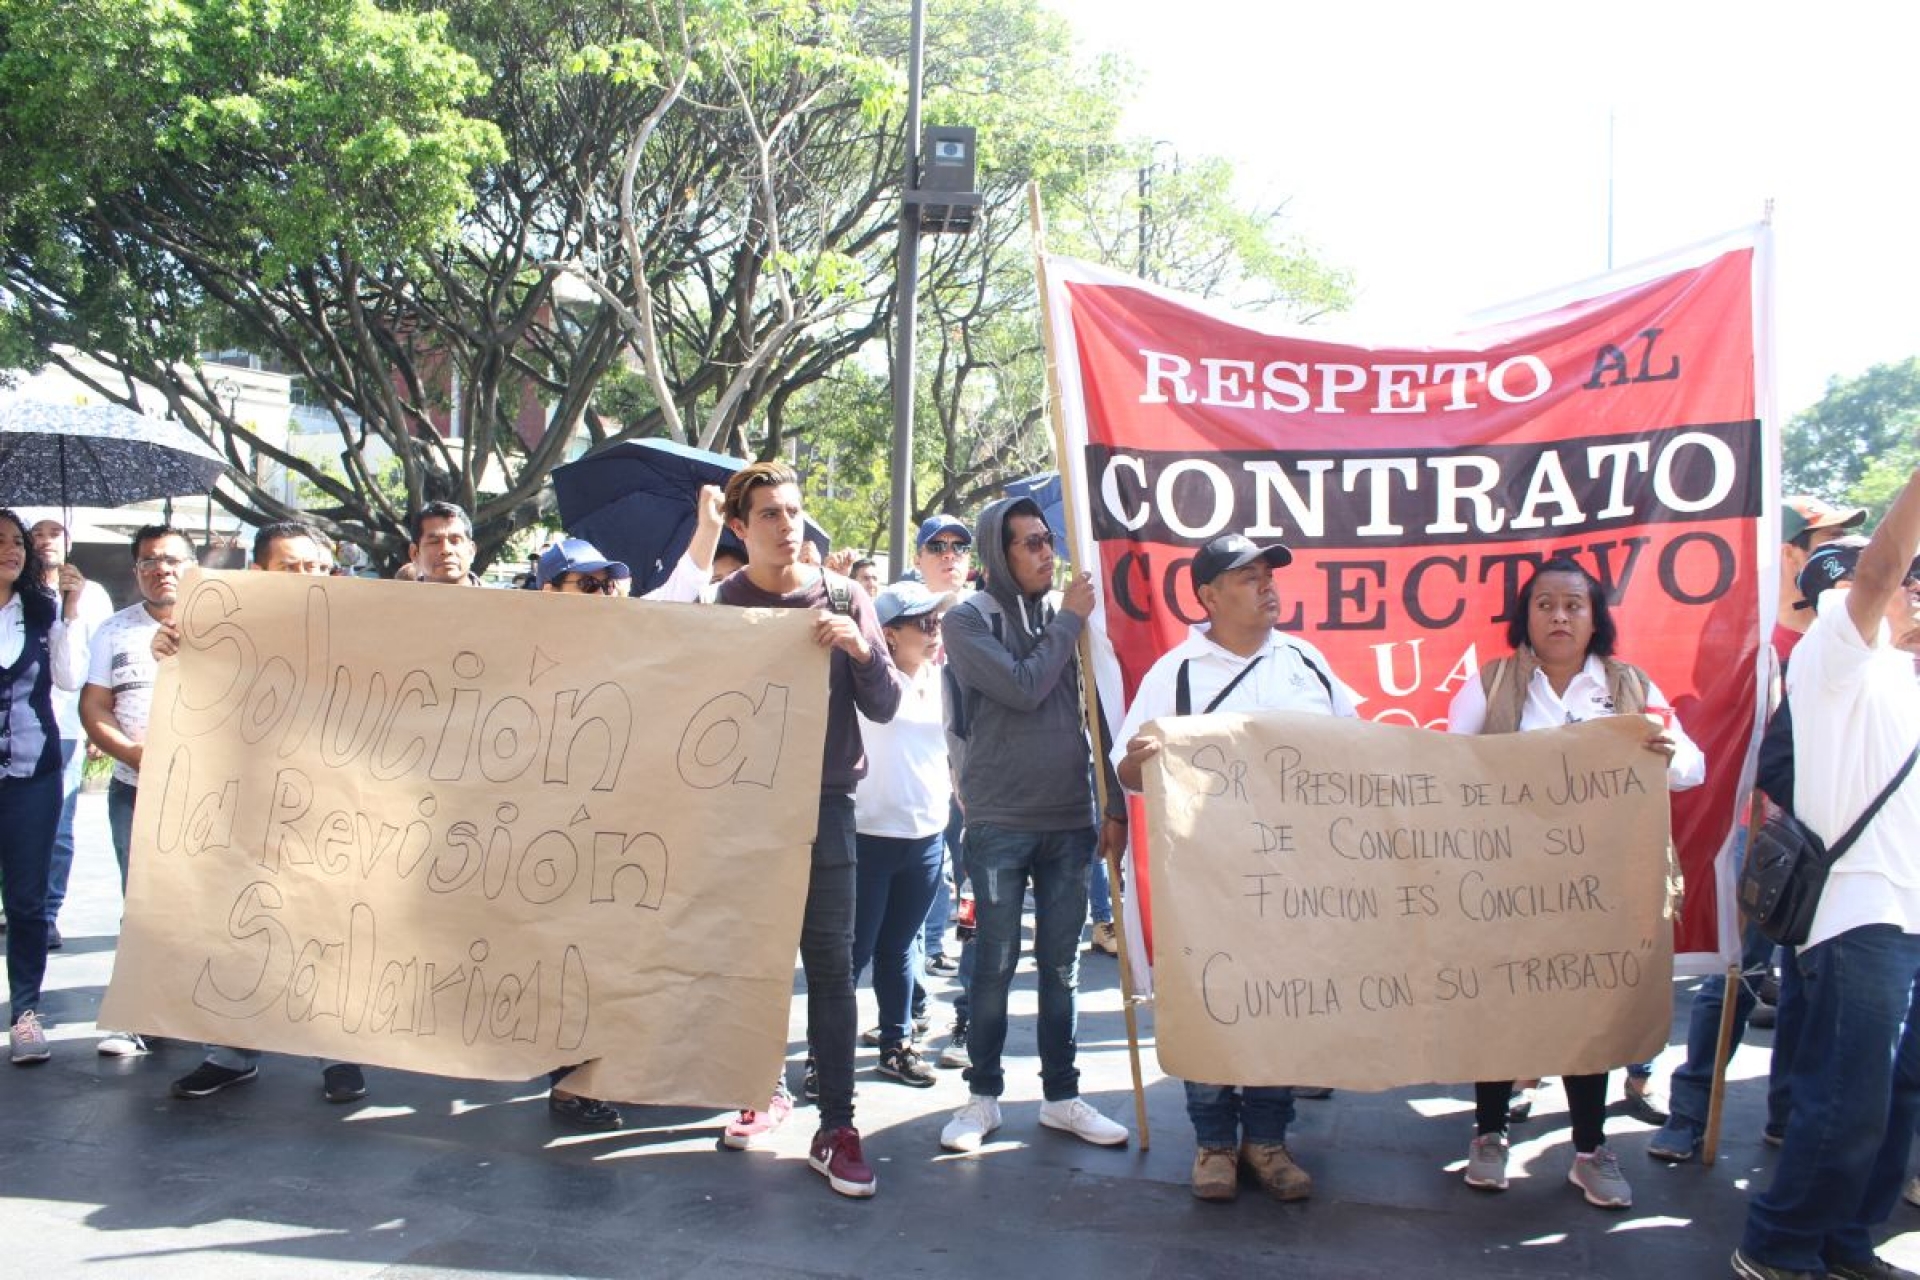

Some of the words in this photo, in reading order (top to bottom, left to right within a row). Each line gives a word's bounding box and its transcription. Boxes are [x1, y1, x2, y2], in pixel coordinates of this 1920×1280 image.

[1138, 348, 1553, 415] RESPETO
[1582, 327, 1681, 391] AL
[1101, 431, 1737, 540] CONTRATO
[1112, 531, 1736, 631] COECTVO
[171, 579, 633, 792] Solución
[676, 682, 789, 789] a
[1461, 783, 1492, 807] DE
[1502, 783, 1534, 805] LA
[1547, 752, 1646, 805] JUNTA
[156, 743, 240, 854] la
[257, 767, 669, 911] Revisión
[1251, 821, 1296, 855] DE
[1543, 823, 1585, 856] SU
[1396, 884, 1440, 917] ES
[192, 880, 590, 1052] Salarial
[1358, 972, 1414, 1012] CON
[1434, 967, 1480, 1001] SU
